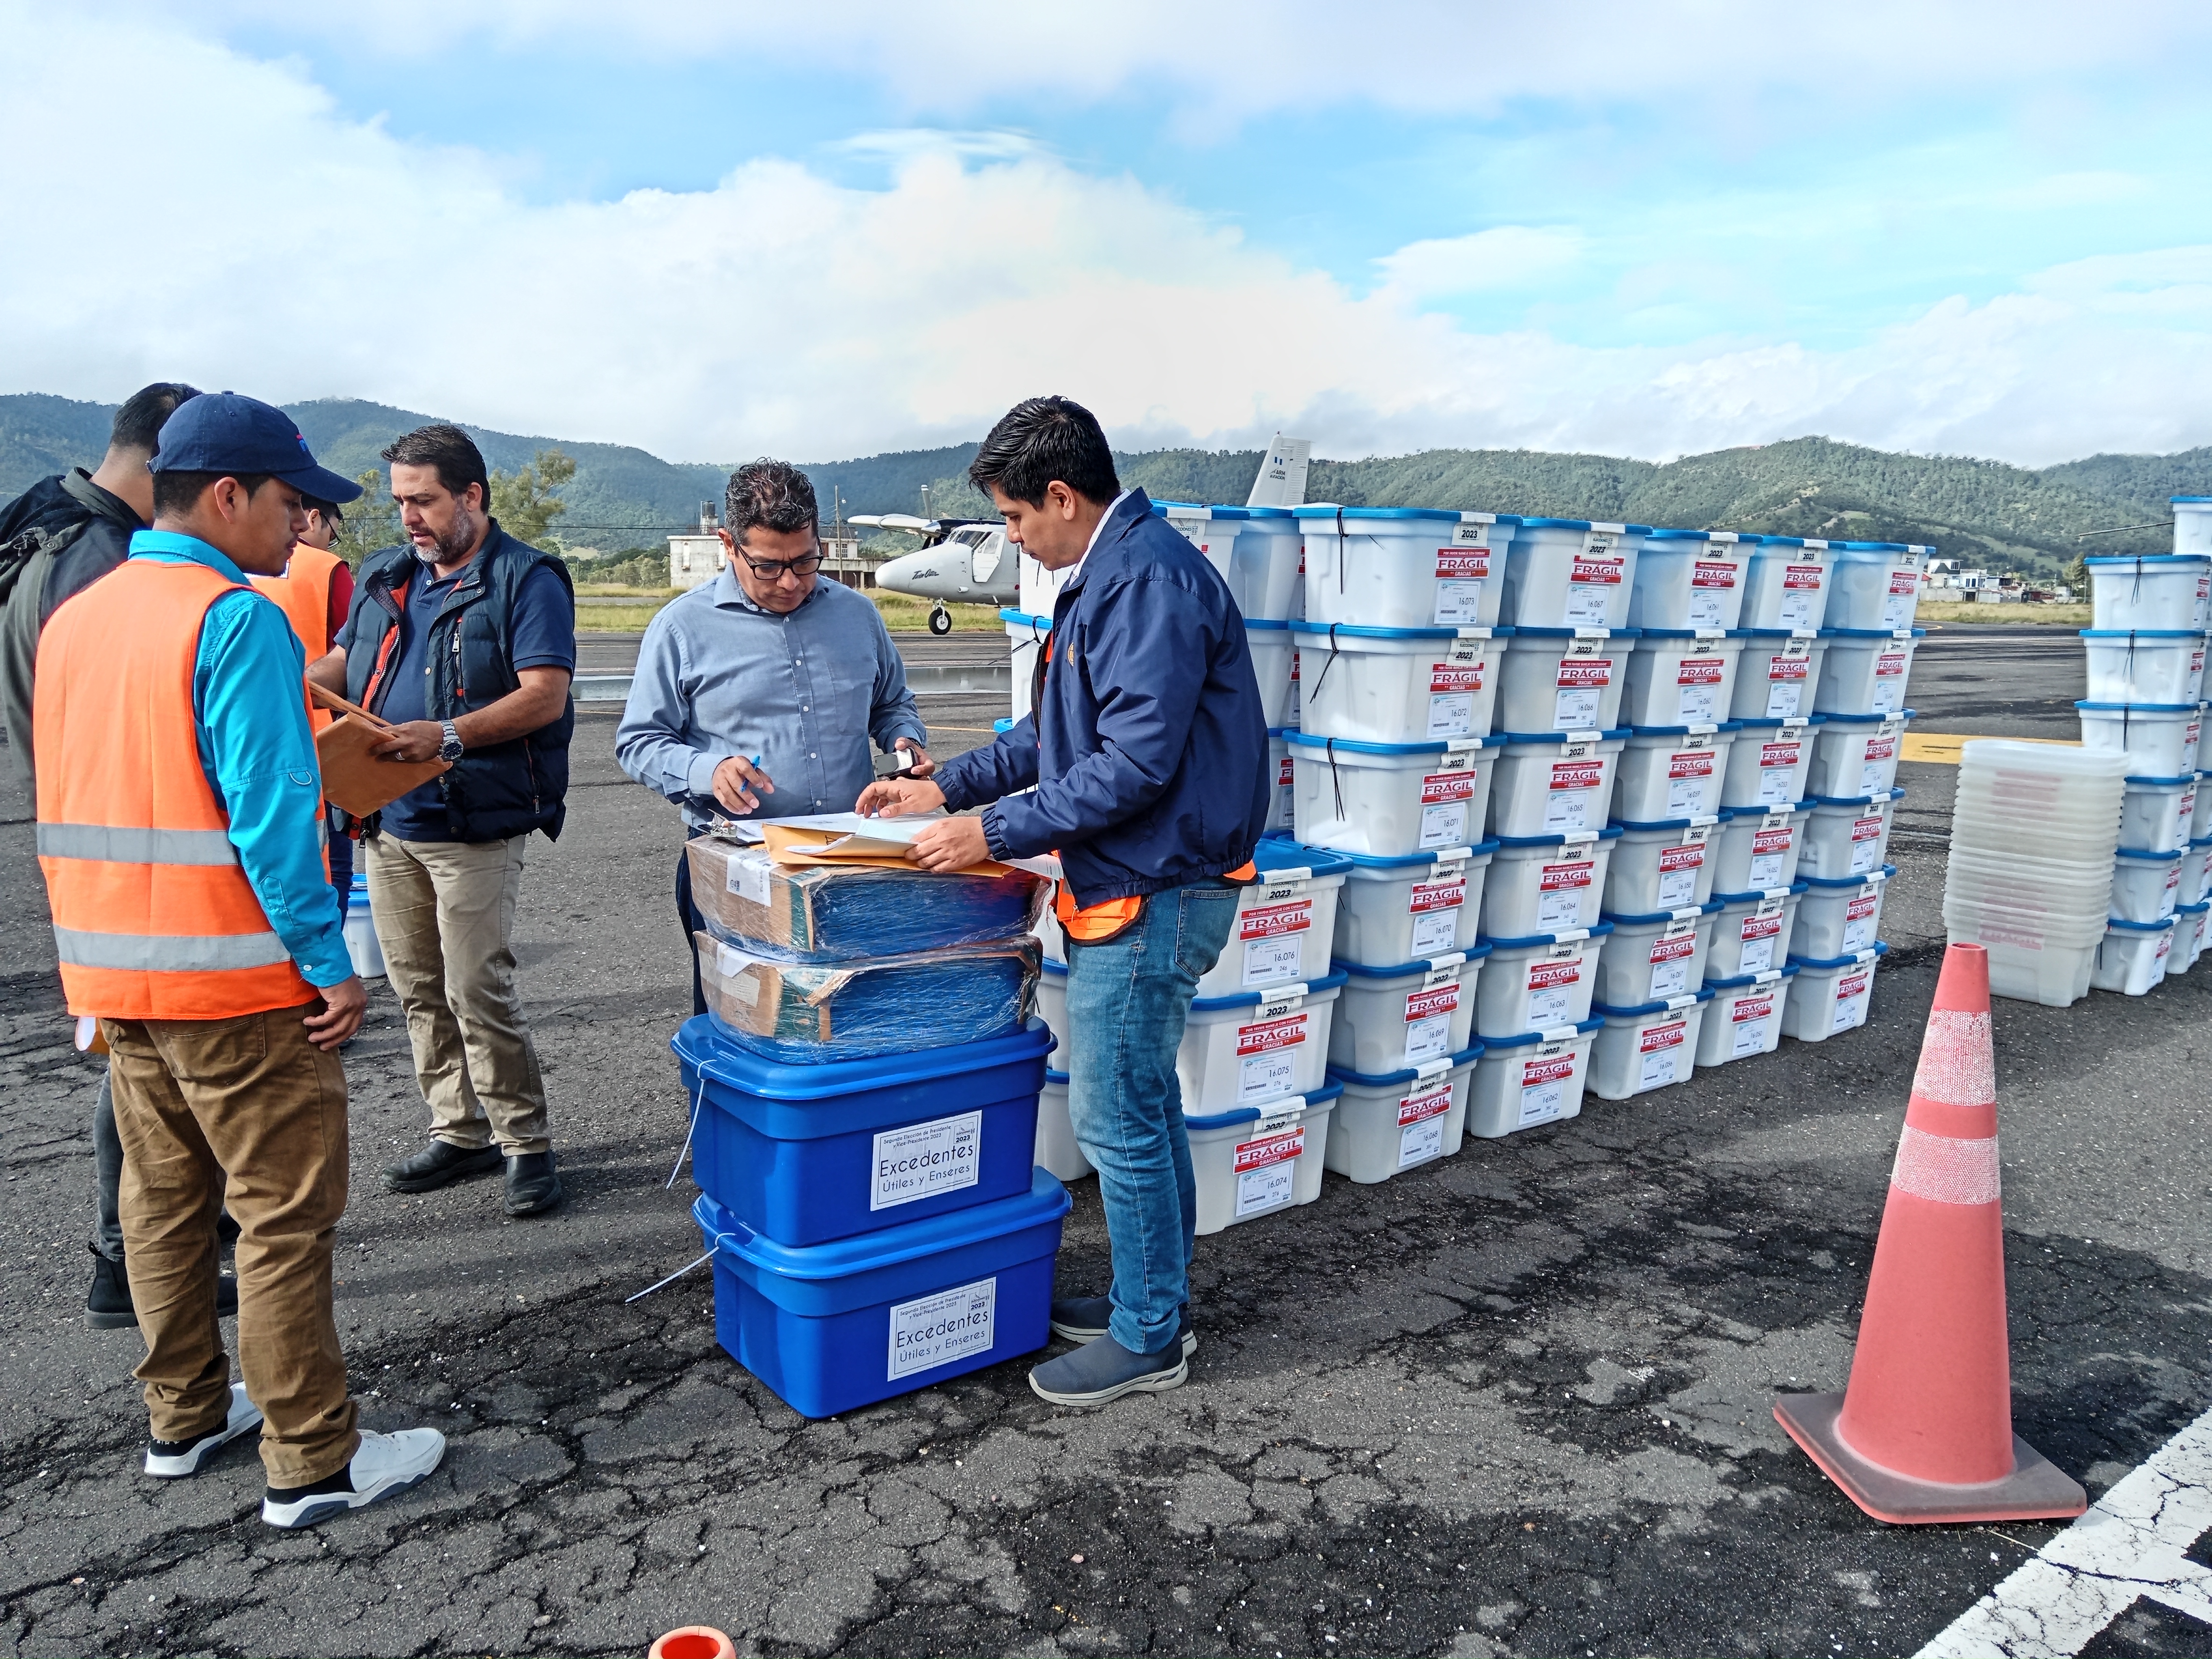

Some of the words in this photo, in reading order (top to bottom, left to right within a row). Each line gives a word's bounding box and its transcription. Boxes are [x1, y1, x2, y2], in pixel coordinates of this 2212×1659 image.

[1462, 530, 1477, 538] 2023
[1439, 558, 1487, 568] FRÁGIL
[1574, 564, 1620, 575] FRÁGIL
[1696, 570, 1733, 580] FRÁGIL
[1787, 573, 1819, 582] FRÁGIL
[1681, 668, 1720, 676] FRÁGIL
[1772, 663, 1806, 671] FRÁGIL
[1434, 672, 1480, 682] FRÁGIL
[1561, 668, 1608, 678] FRÁGIL
[1569, 748, 1585, 756] 2023
[1763, 750, 1797, 759] FRÁGIL
[1672, 760, 1712, 770] FRÁGIL
[1554, 770, 1599, 781] FRÁGIL
[1425, 781, 1472, 794] FRÁGIL
[1755, 835, 1789, 846] FRÁGIL
[1662, 852, 1702, 865] FRÁGIL
[1544, 871, 1590, 882] FRÁGIL
[1269, 890, 1291, 898] 2023
[1414, 889, 1462, 903] FRÁGIL
[1243, 912, 1308, 930] FRÁGIL
[1266, 927, 1287, 935] GRACIAS
[1745, 921, 1779, 933] FRÁGIL
[1653, 943, 1692, 956] FRÁGIL
[1433, 975, 1448, 983] 2023
[1532, 968, 1578, 981] FRÁGIL
[1409, 995, 1456, 1012] FRÁGIL
[1266, 1006, 1287, 1016] 2023
[1735, 1003, 1771, 1015] FRÁGIL
[1668, 1012, 1682, 1020] 2023
[1240, 1026, 1303, 1046] FRÁGIL
[1643, 1031, 1683, 1045] FRÁGIL
[1262, 1041, 1283, 1049] GRACIAS
[1543, 1047, 1560, 1055] 2023
[1525, 1063, 1571, 1078] FRÁGIL
[1402, 1096, 1449, 1117] FRÁGIL
[1417, 1111, 1433, 1119] GRACIAS
[930, 1125, 951, 1133] Presidente
[1264, 1121, 1285, 1130] 2023
[897, 1137, 929, 1147] Vice-Presidente
[1238, 1140, 1300, 1163] FRÁGIL
[880, 1145, 973, 1177] Excedentes
[1259, 1156, 1280, 1166] GRACIAS
[883, 1179, 914, 1192] Útiles
[918, 1176, 924, 1185] y
[930, 1165, 970, 1181] Enseres
[920, 1302, 937, 1310] Elección
[945, 1294, 966, 1302] Presidente
[971, 1302, 985, 1310] 2023
[913, 1306, 945, 1318] Vice-Presidente
[897, 1311, 988, 1348] Excedentes
[900, 1348, 930, 1362] Útiles
[935, 1344, 941, 1353] y
[946, 1331, 985, 1349] Enseres
